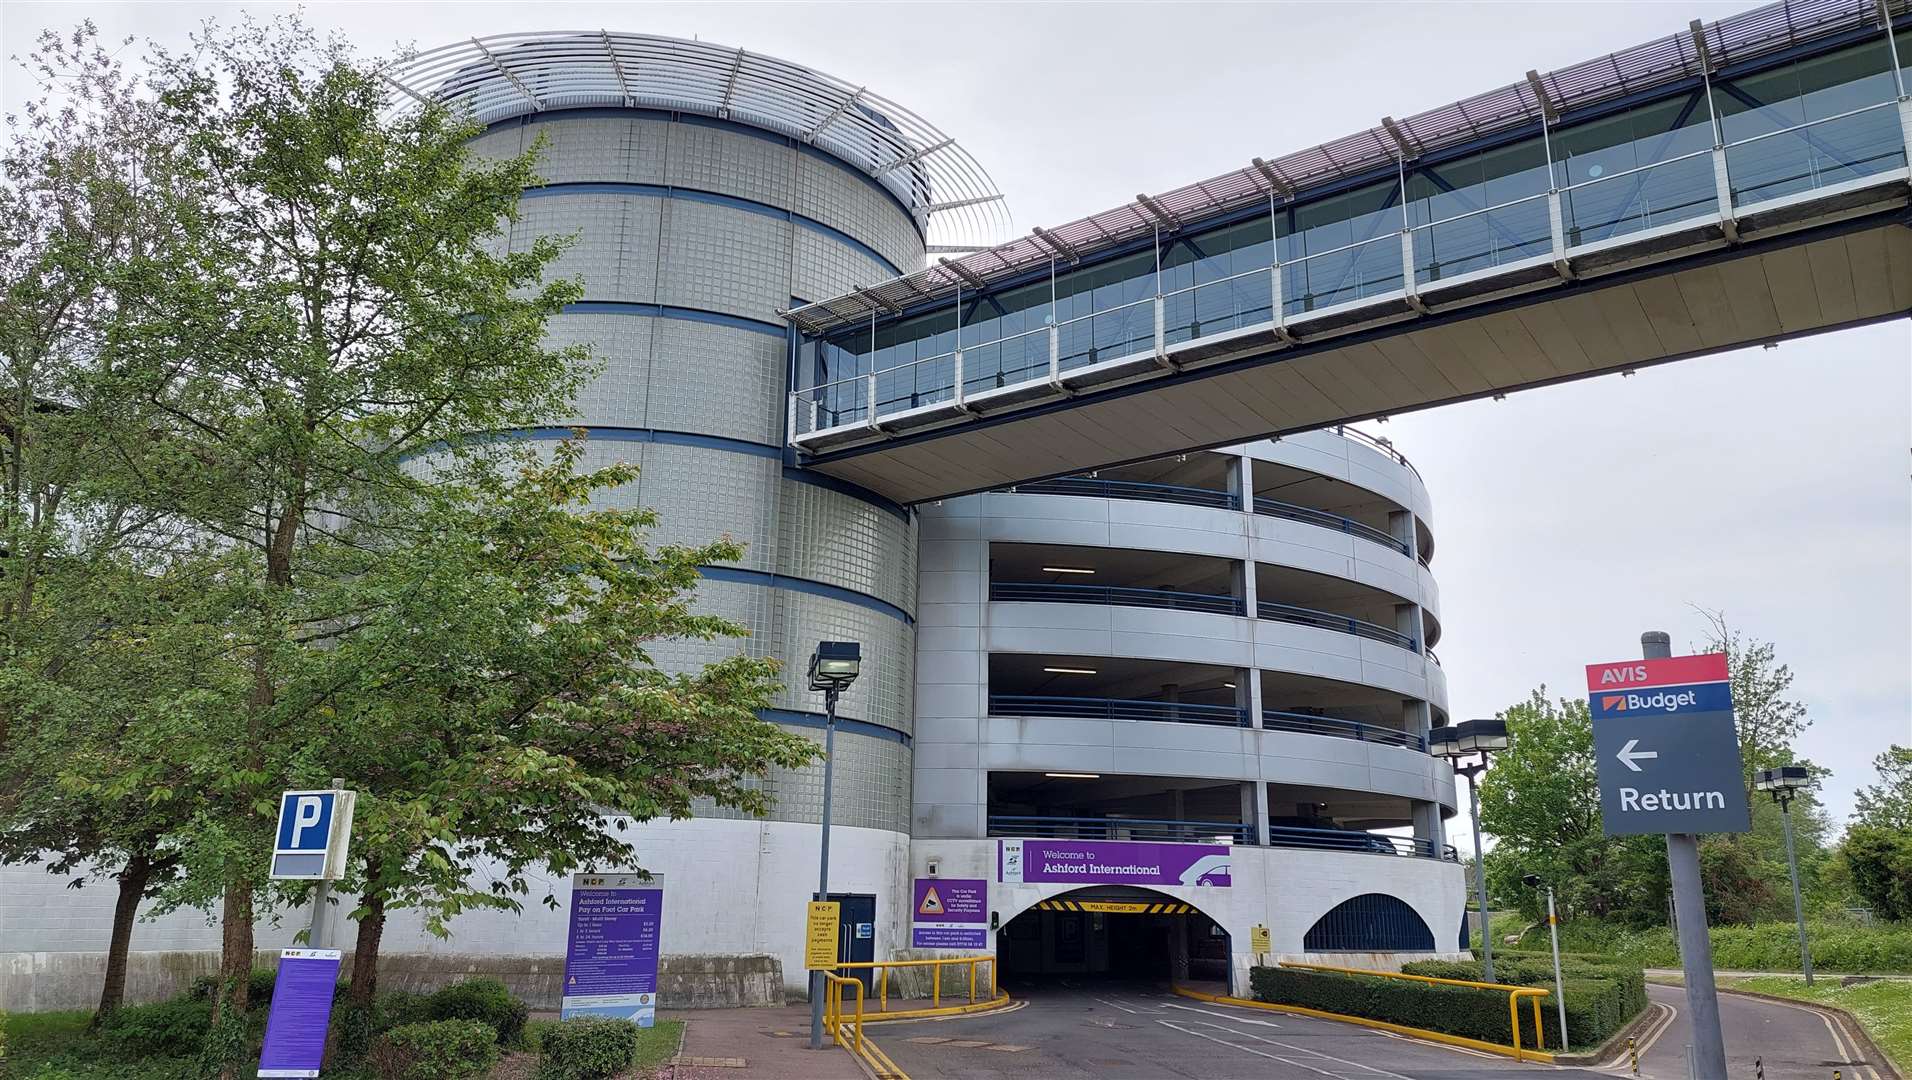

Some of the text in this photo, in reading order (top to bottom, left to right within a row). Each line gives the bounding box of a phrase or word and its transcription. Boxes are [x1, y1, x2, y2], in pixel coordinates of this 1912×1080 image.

[1601, 665, 1648, 684] AVIS
[1627, 690, 1697, 712] Budget
[1619, 787, 1725, 812] Return
[290, 795, 323, 848] P
[1043, 850, 1095, 860] Welcome to
[1043, 863, 1160, 875] Ashford International
